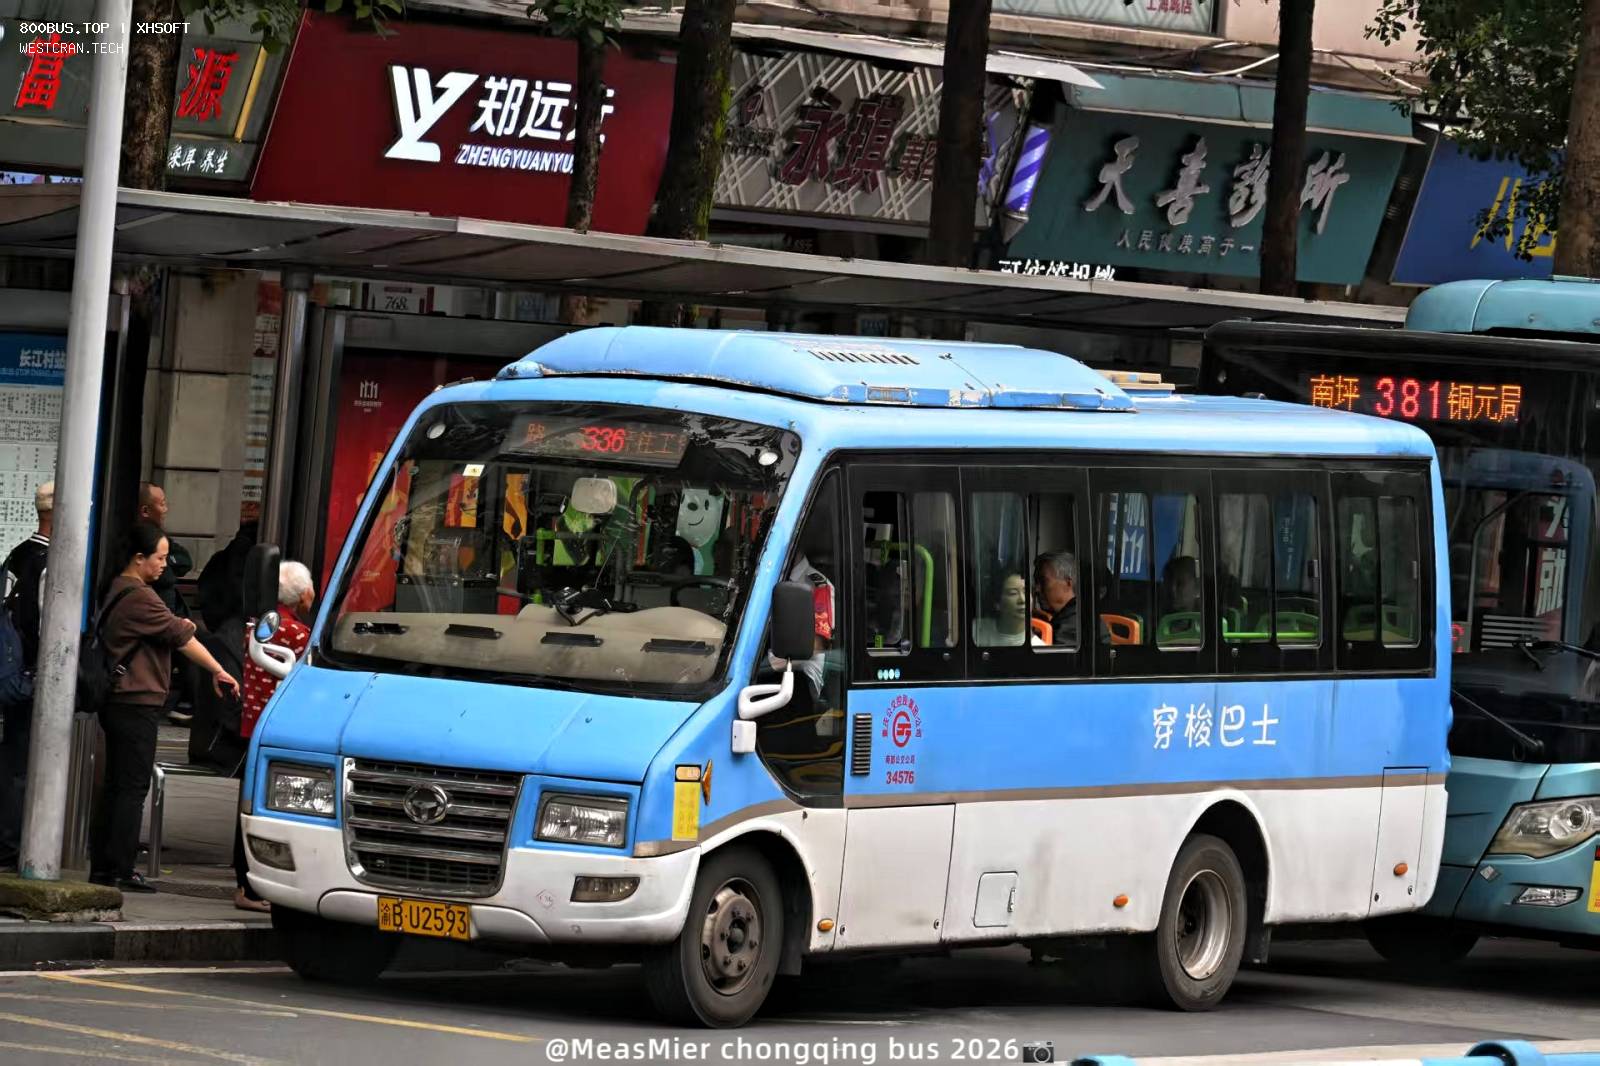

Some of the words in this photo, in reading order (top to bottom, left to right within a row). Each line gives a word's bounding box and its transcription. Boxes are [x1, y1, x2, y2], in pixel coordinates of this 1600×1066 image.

[176, 47, 240, 121] 源
[1310, 374, 1361, 410] 南坪
[1375, 377, 1440, 419] 381
[1447, 382, 1522, 423] 铜元局
[1153, 702, 1279, 749] 穿梭巴士
[886, 770, 915, 784] 34576
